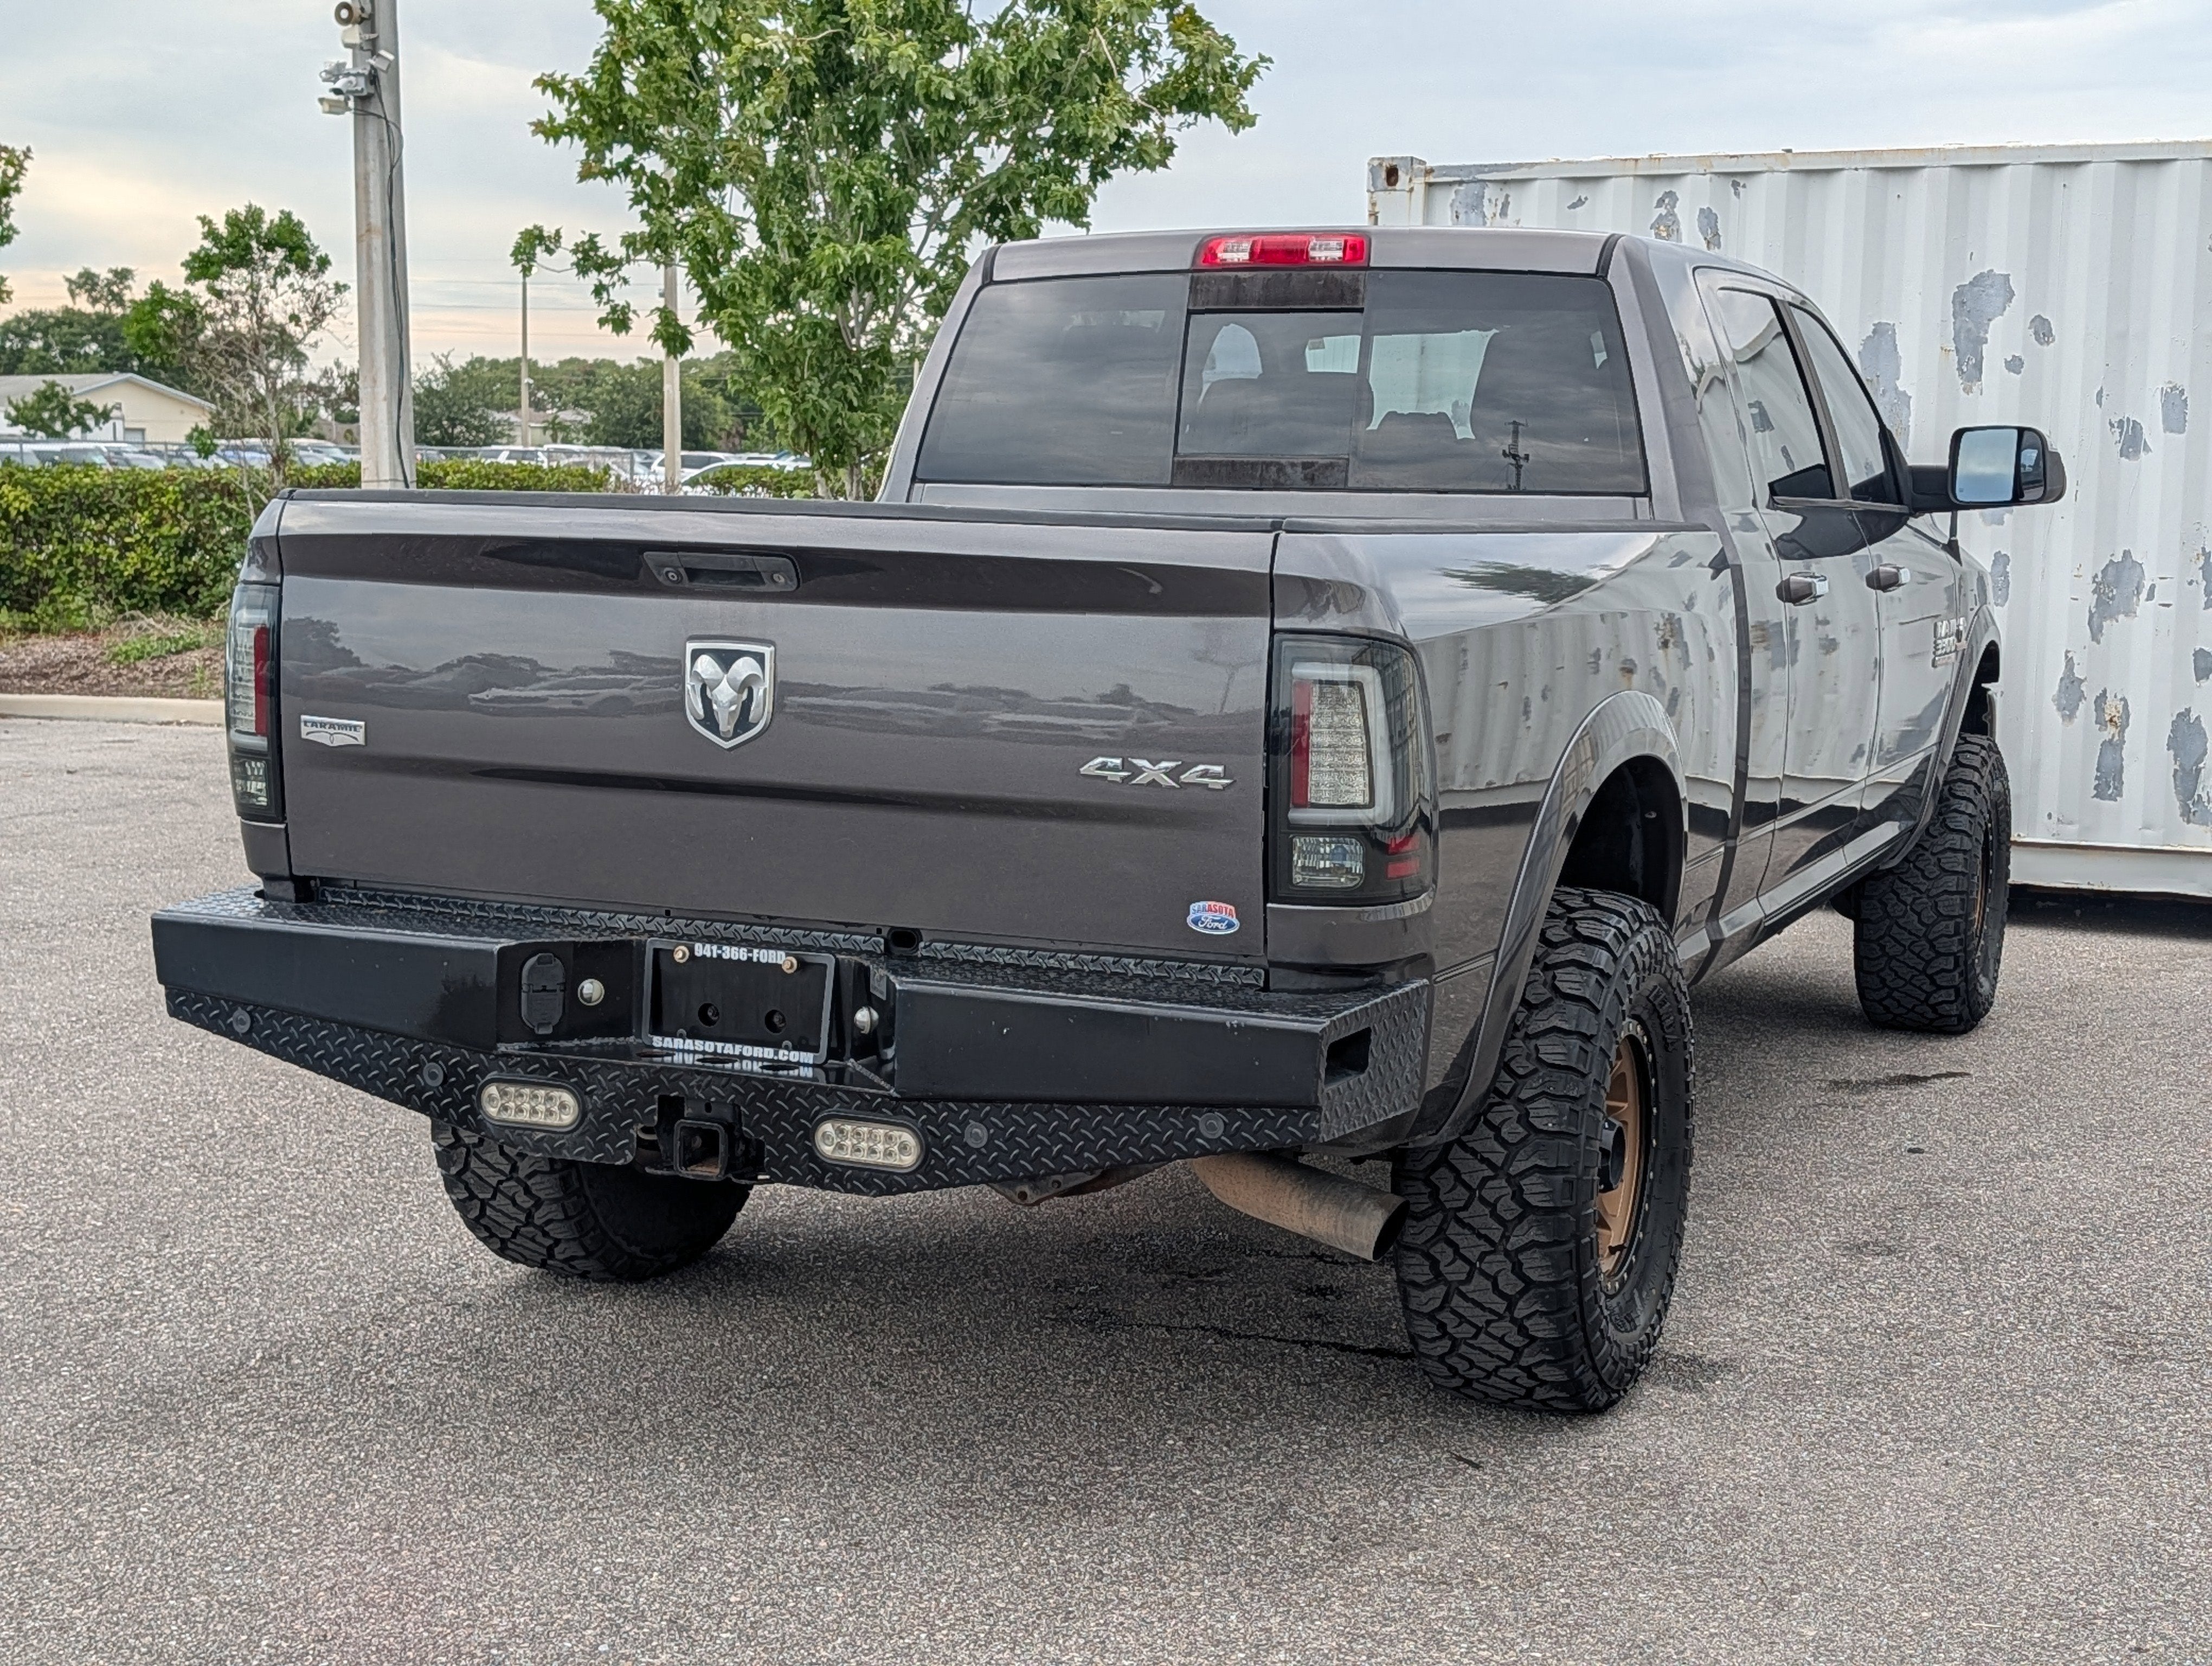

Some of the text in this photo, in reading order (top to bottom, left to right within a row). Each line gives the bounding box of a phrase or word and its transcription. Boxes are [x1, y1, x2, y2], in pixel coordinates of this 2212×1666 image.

[1191, 904, 1234, 918] SARASOTA
[1198, 915, 1229, 929] Ford
[693, 943, 786, 964] 941-366-FORD
[652, 1035, 814, 1064] SARASOTAFORD.COM
